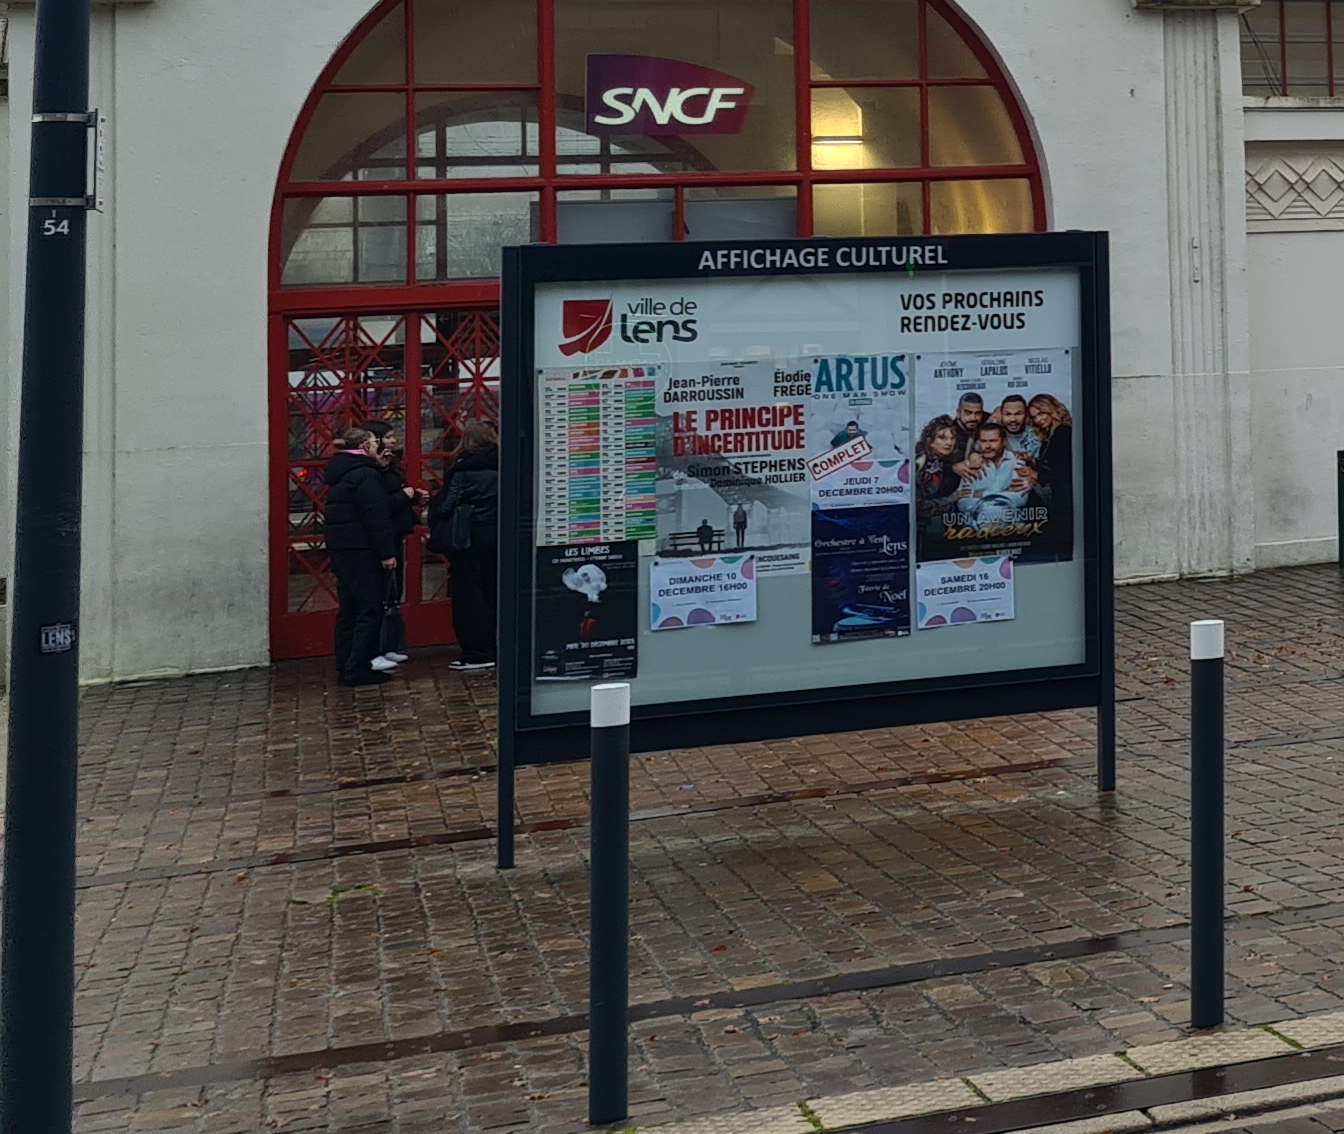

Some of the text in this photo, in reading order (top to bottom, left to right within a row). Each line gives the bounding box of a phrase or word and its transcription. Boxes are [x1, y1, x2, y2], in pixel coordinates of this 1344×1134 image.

[594, 87, 744, 126] SNCF
[43, 219, 70, 236] 54
[698, 245, 948, 270] AFFICHAGE CULTUREL
[628, 297, 697, 316] ville de
[900, 290, 1044, 311] VOS PROCHAINS
[900, 313, 1026, 333] RENDEZ-VOUS
[668, 374, 740, 391] Jean-Pierre
[815, 355, 906, 393] ARTUS
[663, 387, 744, 403] DARROUSSIN
[673, 404, 805, 433] LE PRINCIPE
[673, 428, 806, 457] D'INCERTITUDE
[812, 441, 868, 475] COMPLET
[687, 458, 806, 478] Simon STEPHENS
[765, 472, 806, 485] HOLLIER
[843, 476, 880, 486] JEUDI 7
[818, 487, 873, 497] DECEMBRE
[943, 507, 1049, 526] UN AVENIR
[883, 534, 907, 556] Lens
[669, 572, 737, 585] DIMANCHE 10
[940, 574, 976, 585] SAMEDI
[658, 584, 715, 597] DECEMBRE
[924, 585, 976, 597] DECEMBRE
[41, 629, 71, 647] LENS
